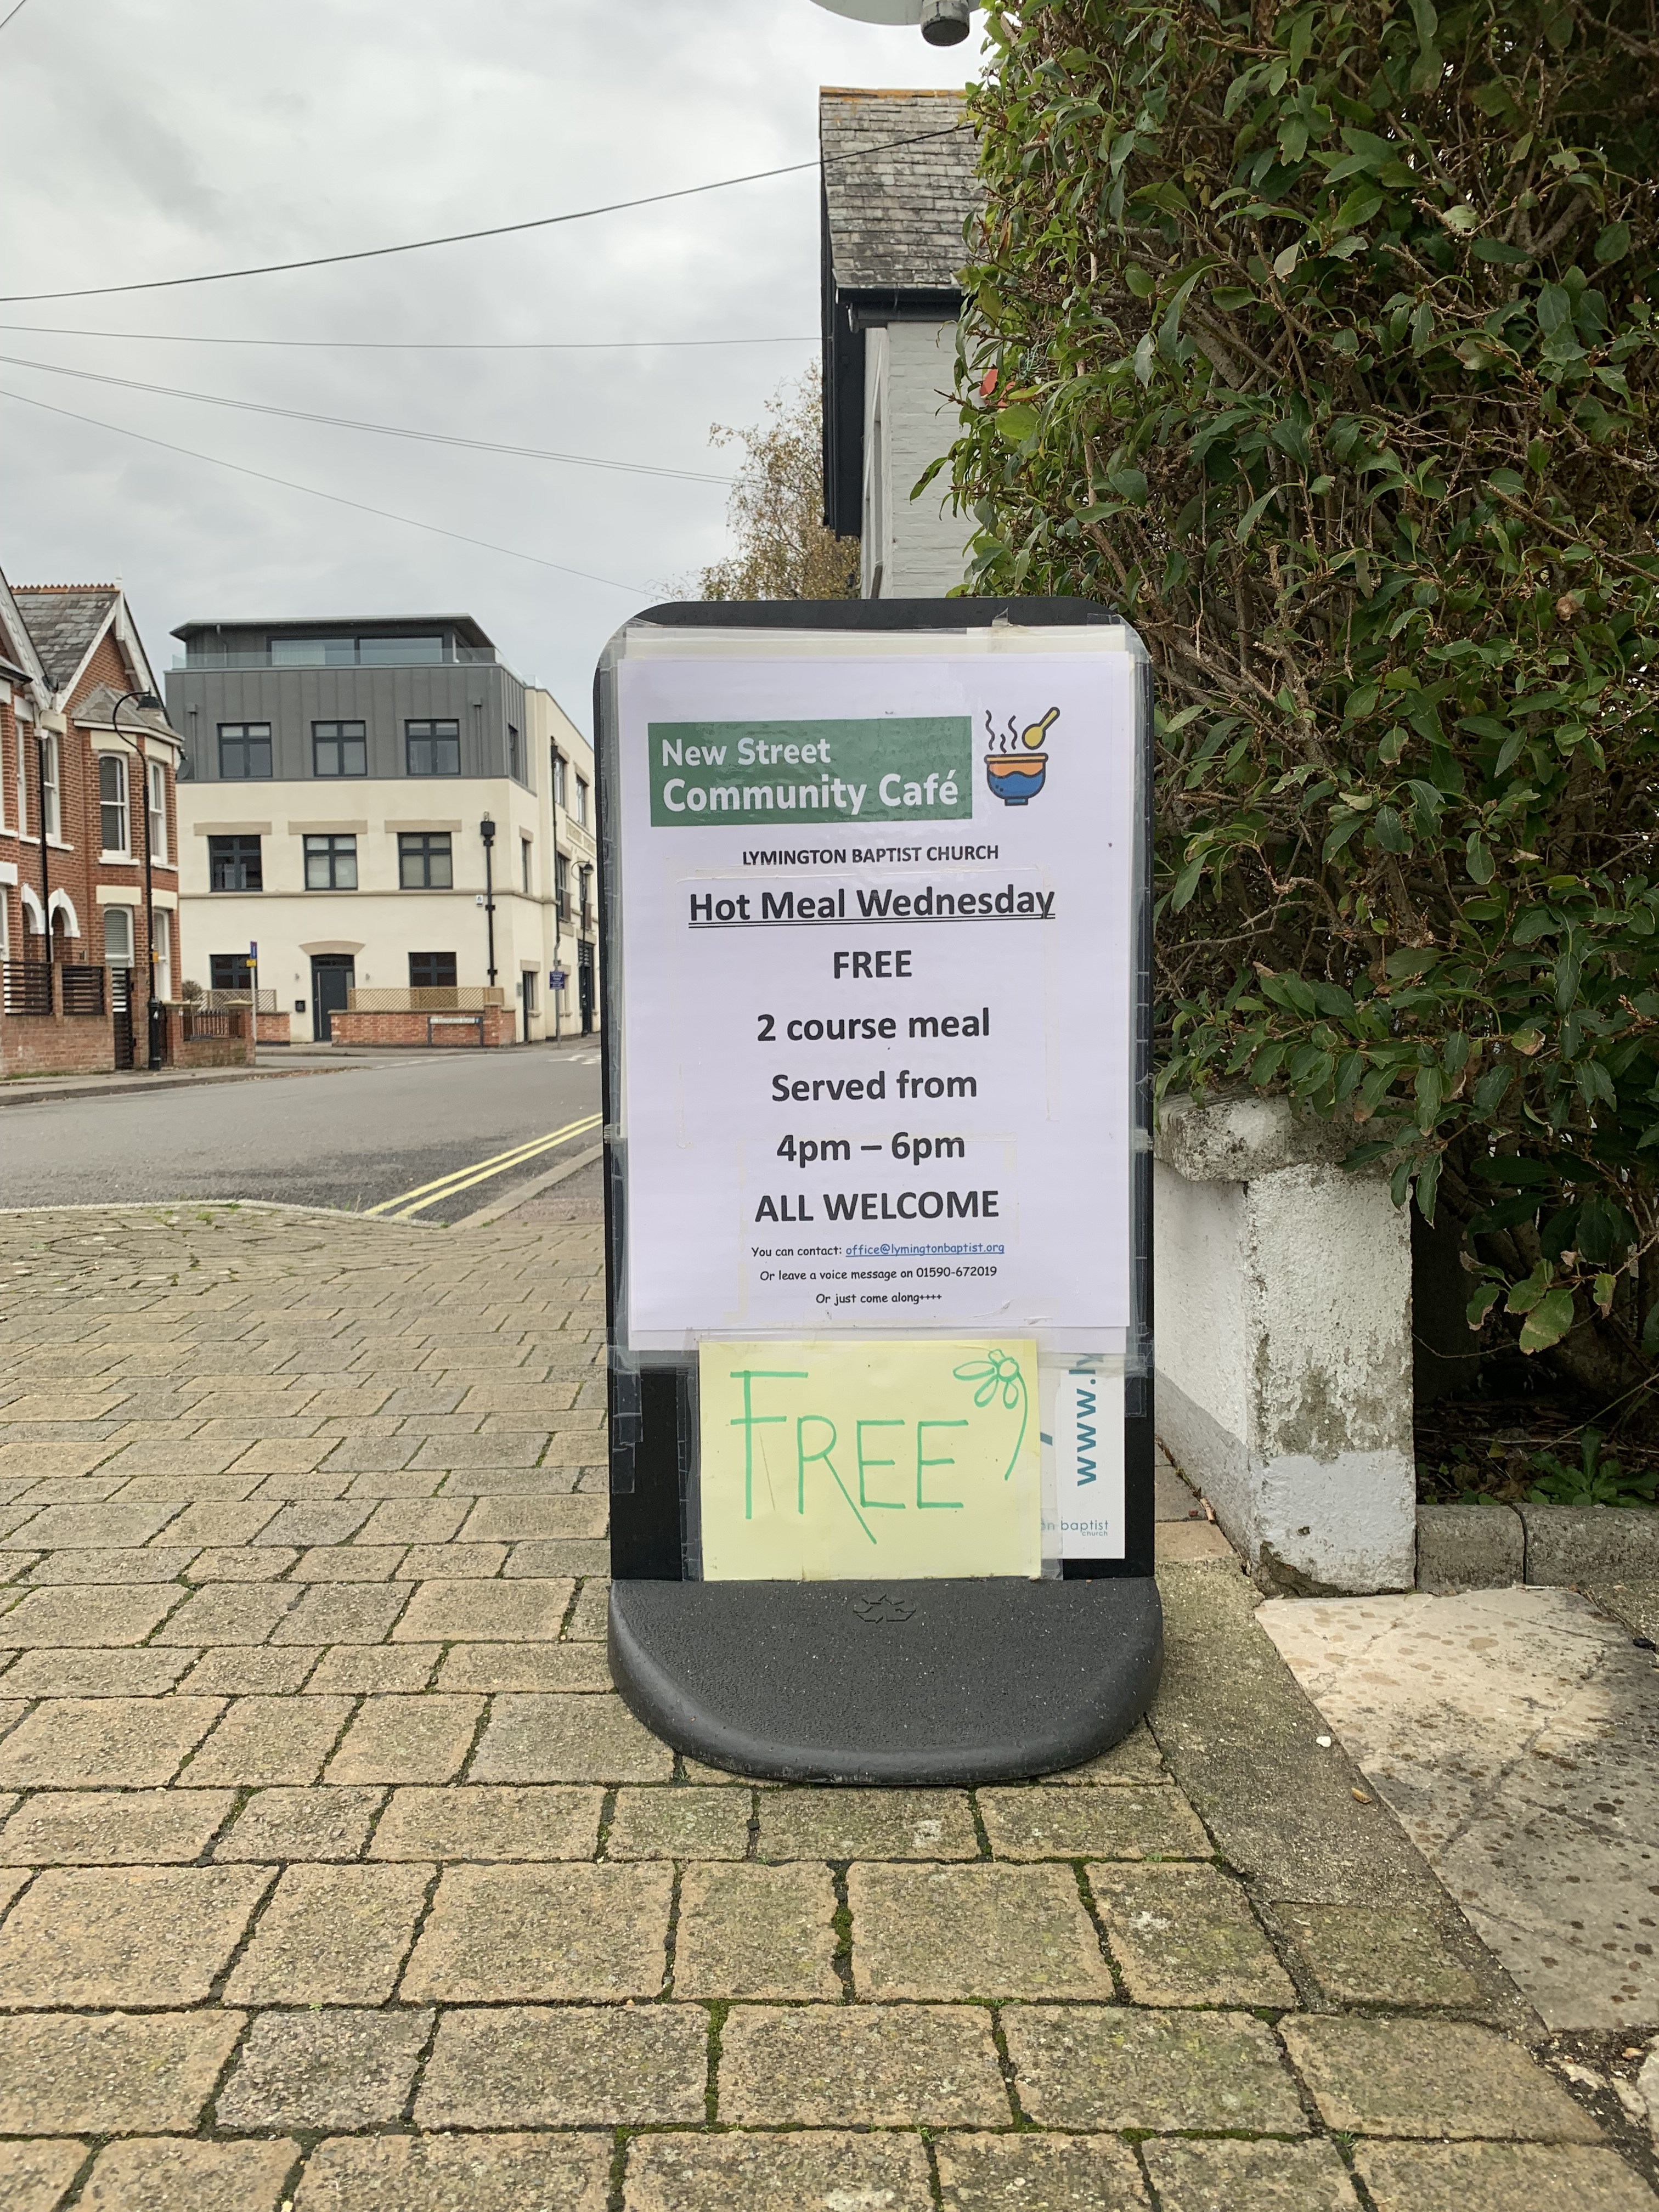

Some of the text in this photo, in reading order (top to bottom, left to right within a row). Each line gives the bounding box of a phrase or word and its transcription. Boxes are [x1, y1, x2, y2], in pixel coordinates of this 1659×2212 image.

[663, 738, 831, 766] New Street
[664, 770, 958, 815] Community Café
[742, 845, 998, 865] LYMINGTON BAPTIST CHURCH
[689, 885, 1054, 922] Hot Meal Wednesday
[834, 950, 912, 979] FREE
[758, 1007, 989, 1041] 2 course meal
[772, 1070, 976, 1102] Served from
[777, 1135, 850, 1168] 4pm
[892, 1132, 964, 1165] 6pm
[755, 1191, 998, 1222] ALL WELCOME
[752, 1247, 771, 1256] You
[797, 1246, 842, 1256] contact:
[846, 1243, 1005, 1257] office@lymingtonbaptist.org
[760, 1271, 775, 1280] Or
[779, 1270, 806, 1280] leave
[820, 1270, 847, 1279] voice
[851, 1271, 896, 1281] message
[917, 1266, 997, 1277] 01590-672019
[816, 1294, 831, 1303] Or
[834, 1294, 856, 1306] just
[891, 1292, 941, 1304] along++++
[730, 1370, 969, 1545] FREE
[1061, 1520, 1108, 1532] baptist
